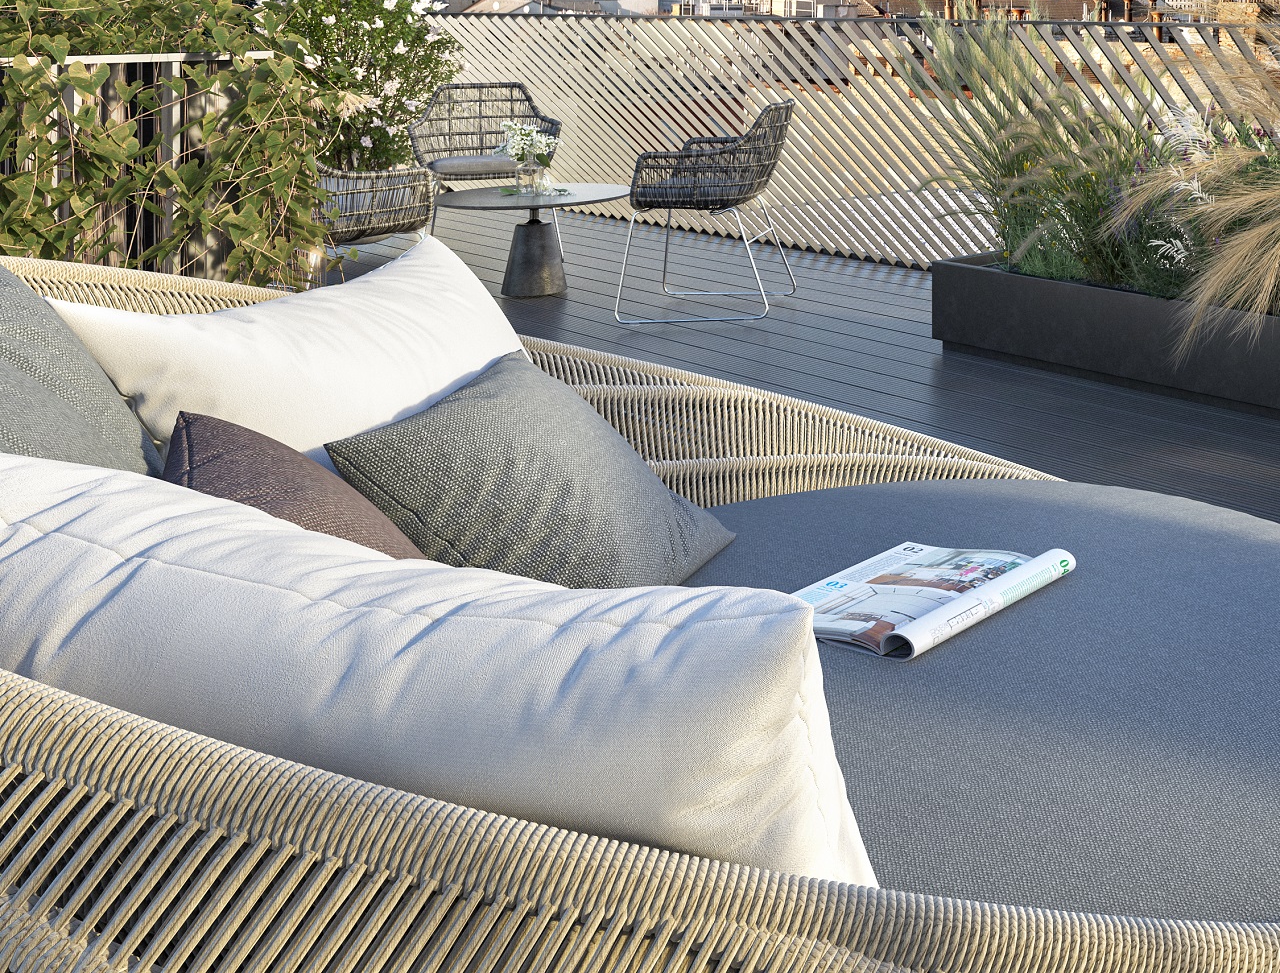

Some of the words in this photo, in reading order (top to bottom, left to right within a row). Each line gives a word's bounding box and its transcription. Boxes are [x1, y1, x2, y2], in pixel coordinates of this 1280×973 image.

[902, 546, 924, 554] 02
[1059, 559, 1070, 576] 04
[825, 580, 848, 589] 03
